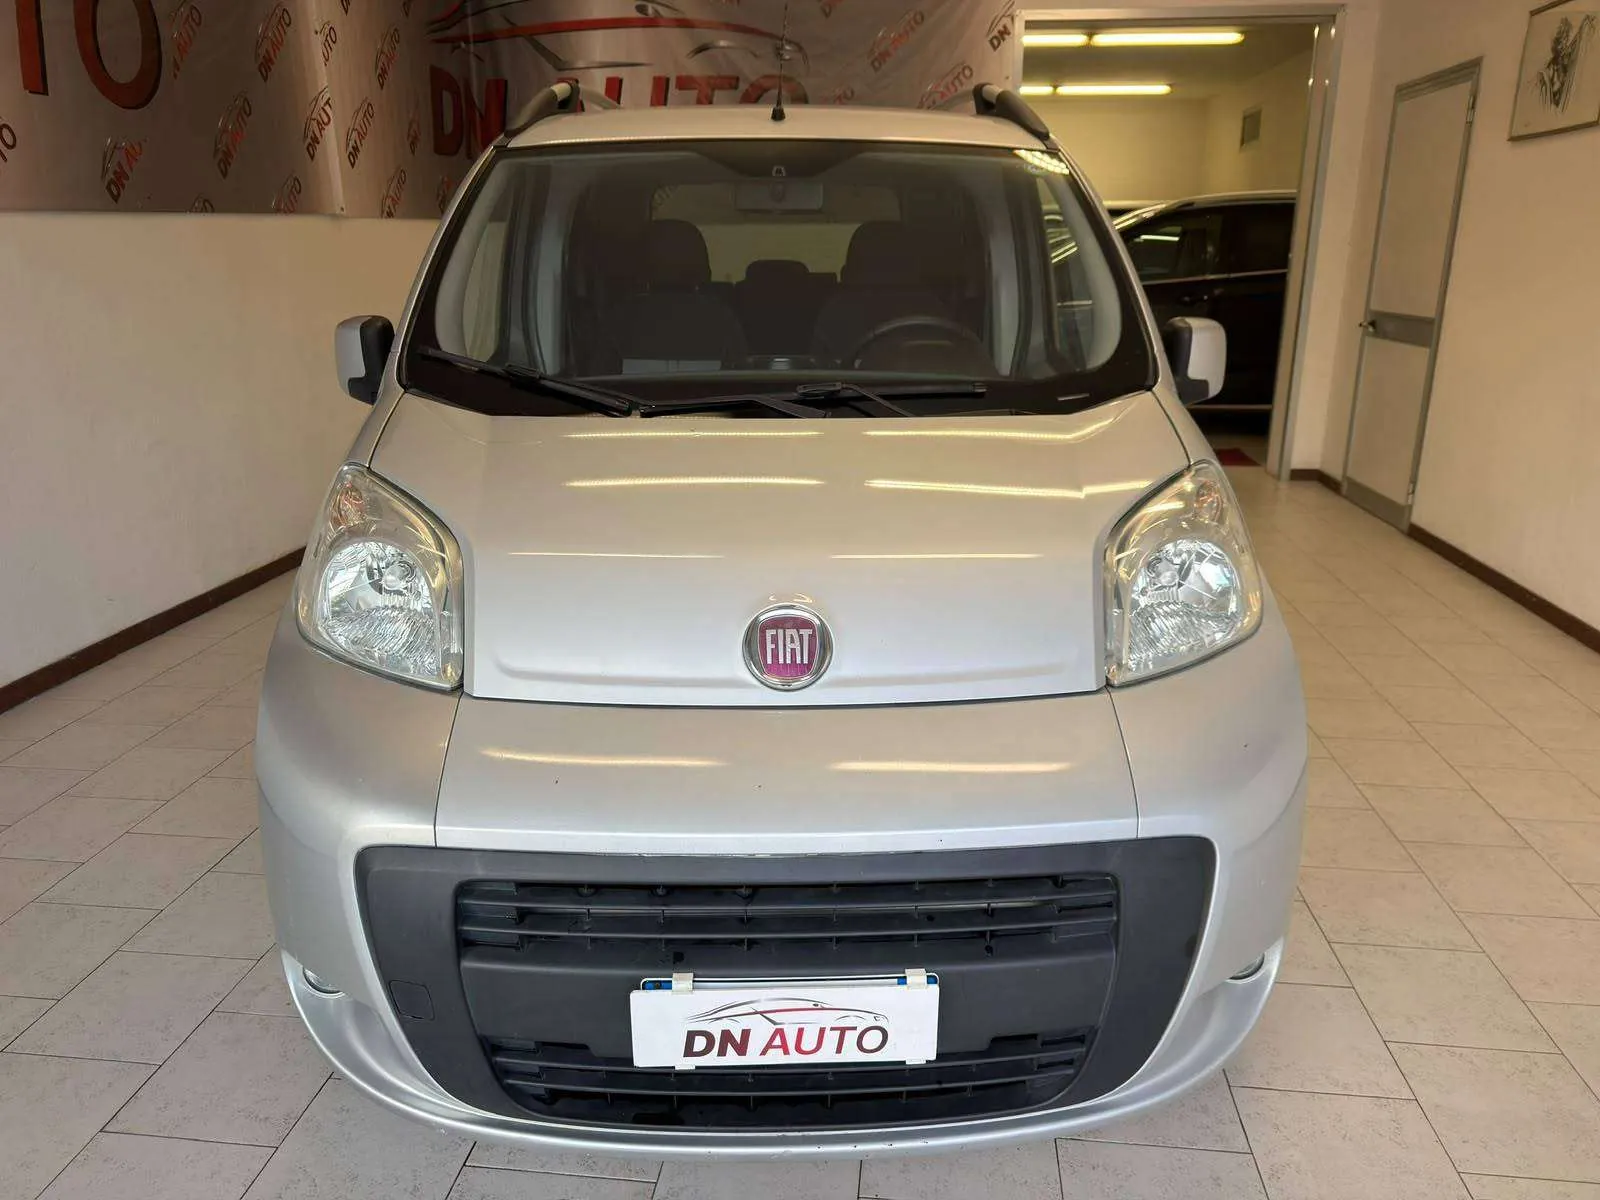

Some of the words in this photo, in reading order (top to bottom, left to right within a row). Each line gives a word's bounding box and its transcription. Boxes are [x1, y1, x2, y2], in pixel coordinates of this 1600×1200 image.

[258, 54, 275, 82] DN
[269, 8, 292, 60] AUTO
[322, 26, 337, 66] UTO
[870, 51, 891, 72] DN
[890, 10, 925, 50] AUTO
[989, 24, 1011, 51] DN
[938, 65, 974, 101] AUTO
[227, 97, 252, 154] AUTO
[306, 131, 321, 161] DN
[316, 97, 333, 138] AUT
[348, 139, 361, 169] DN
[356, 102, 375, 147] AUTO
[430, 65, 508, 160] DN
[106, 160, 130, 204] DN
[765, 628, 812, 665] FIAT
[683, 1028, 752, 1058] DN
[759, 1025, 889, 1057] AUTO
